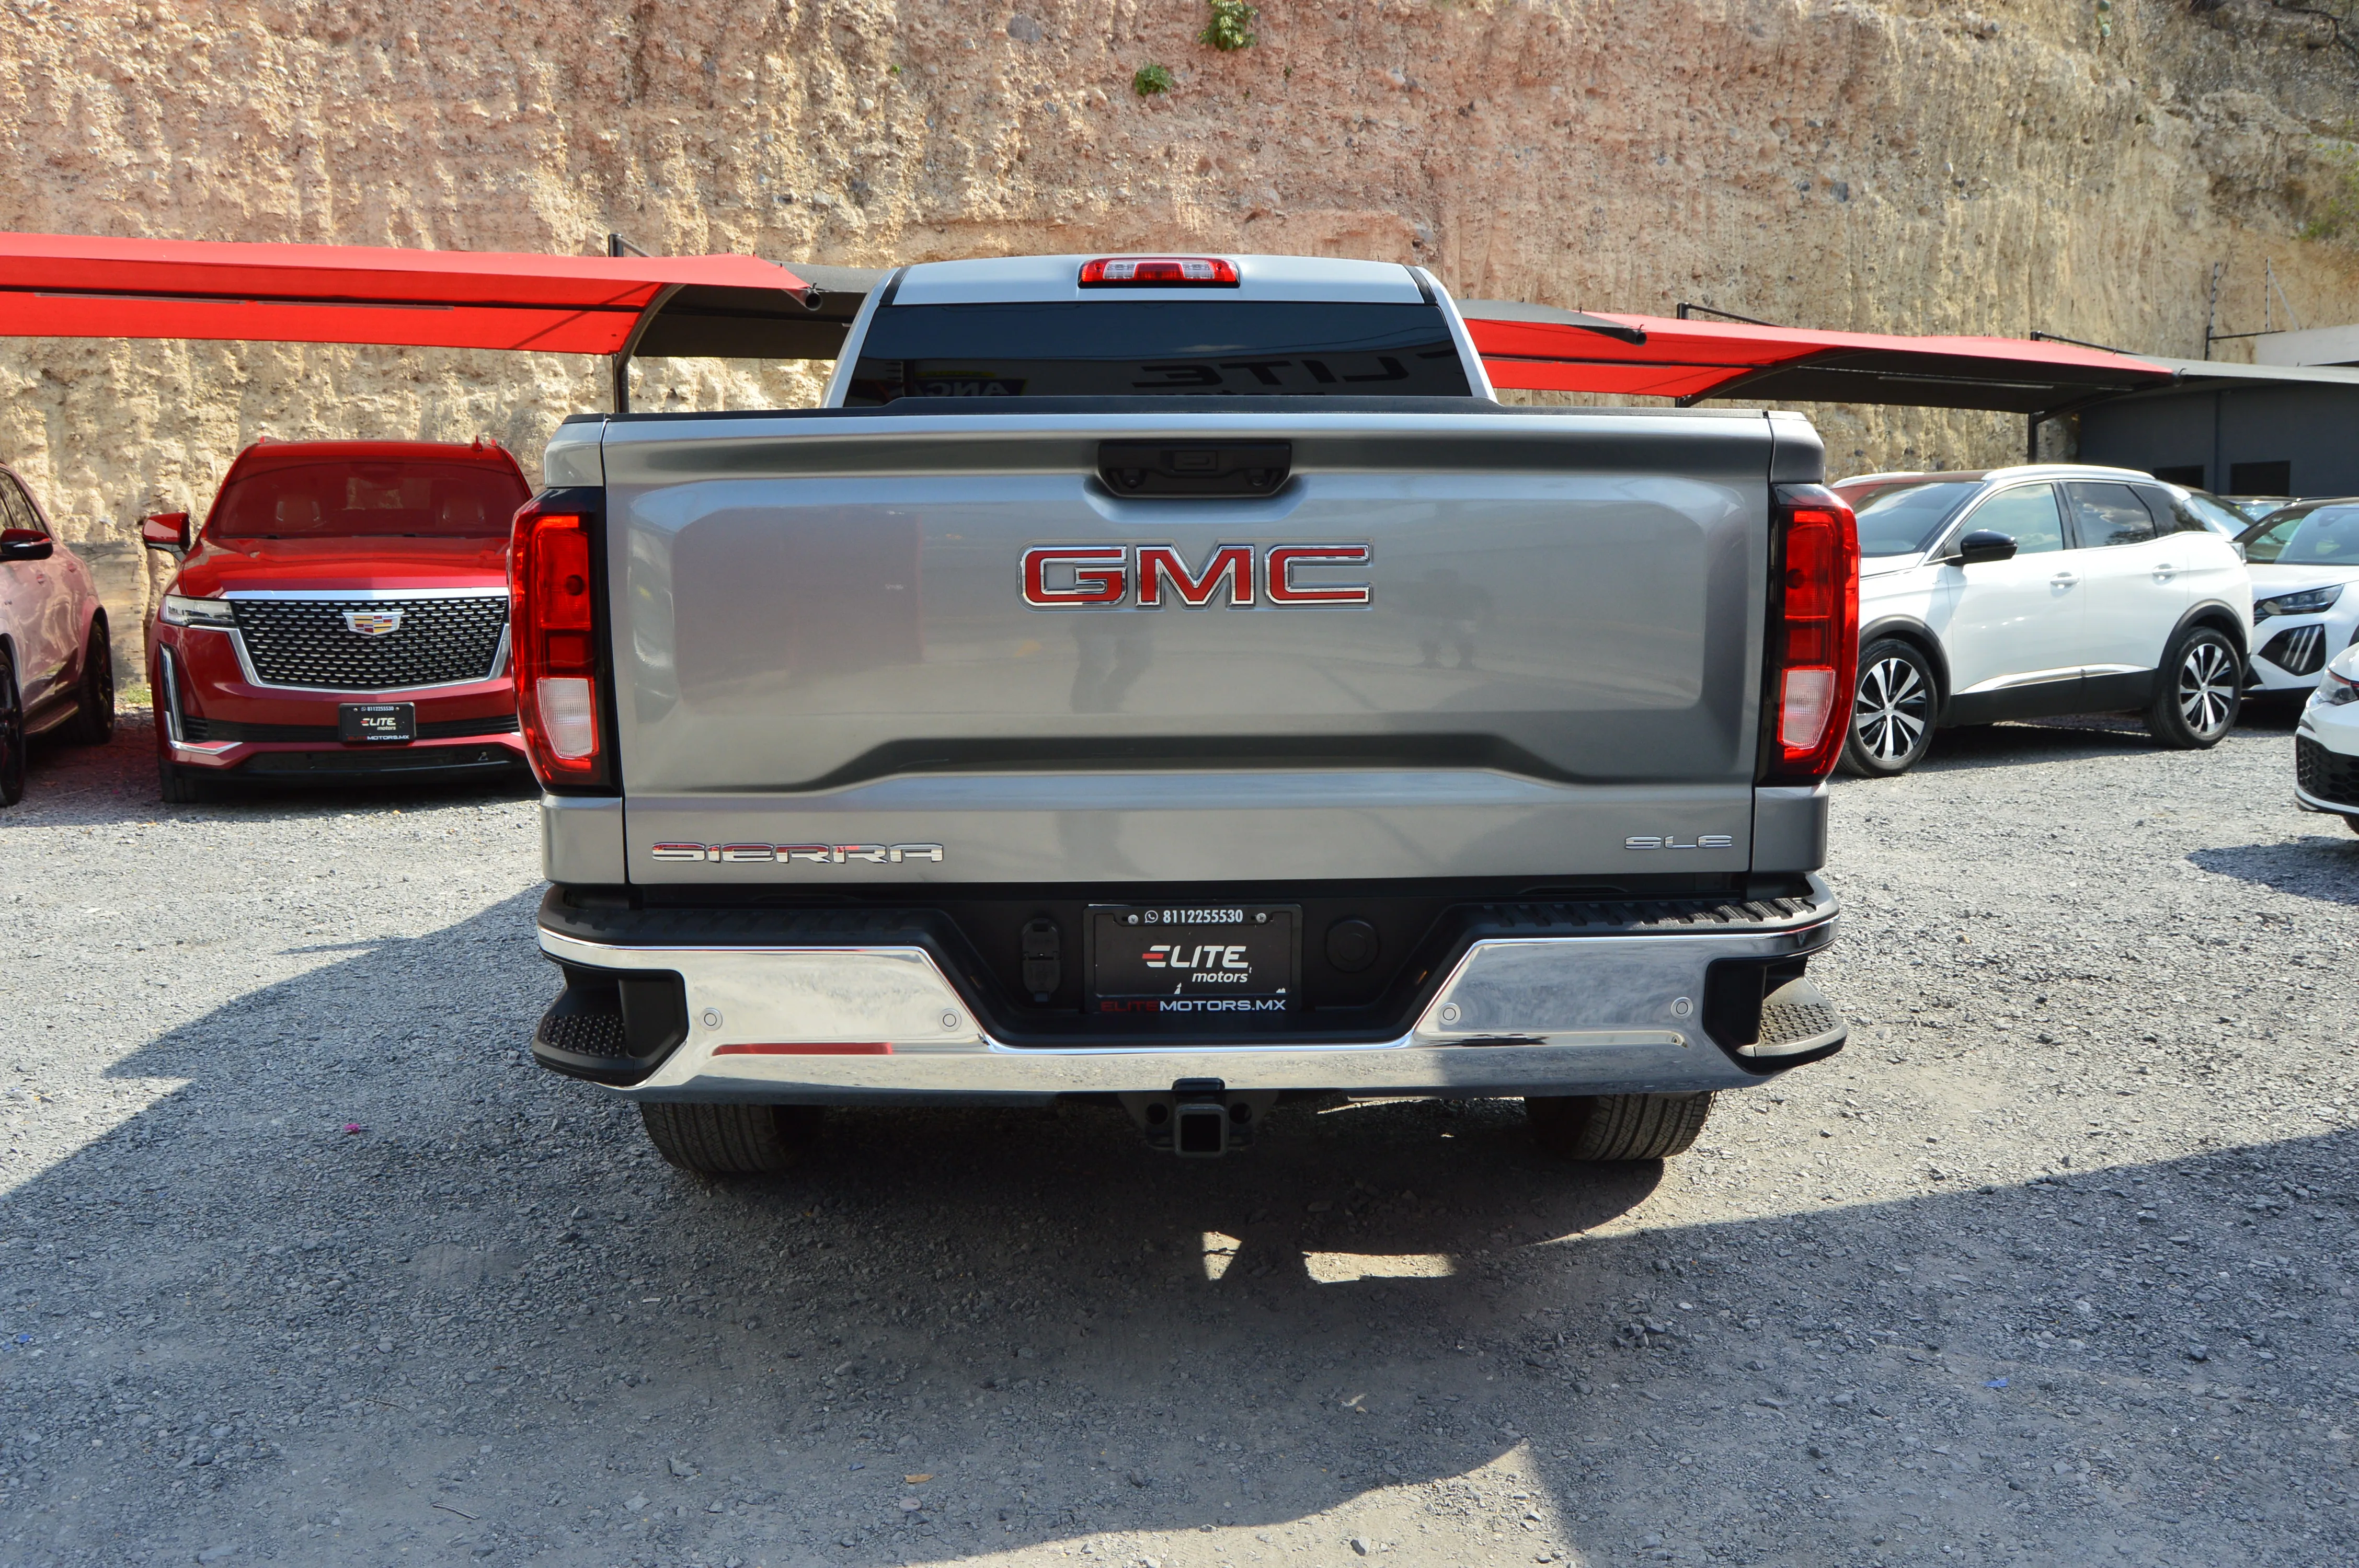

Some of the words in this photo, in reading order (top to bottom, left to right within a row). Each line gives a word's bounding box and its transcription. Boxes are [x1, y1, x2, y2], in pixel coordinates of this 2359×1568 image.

[1020, 544, 1371, 606] GMC
[360, 717, 396, 726] ELITE
[1625, 835, 1732, 850] SLE
[652, 842, 944, 863] SIERRA
[1162, 909, 1243, 924] 8112255530
[1142, 945, 1249, 968] ELITE
[1192, 971, 1248, 983] motors
[1100, 999, 1286, 1012] ELITEMOTORS.MX
